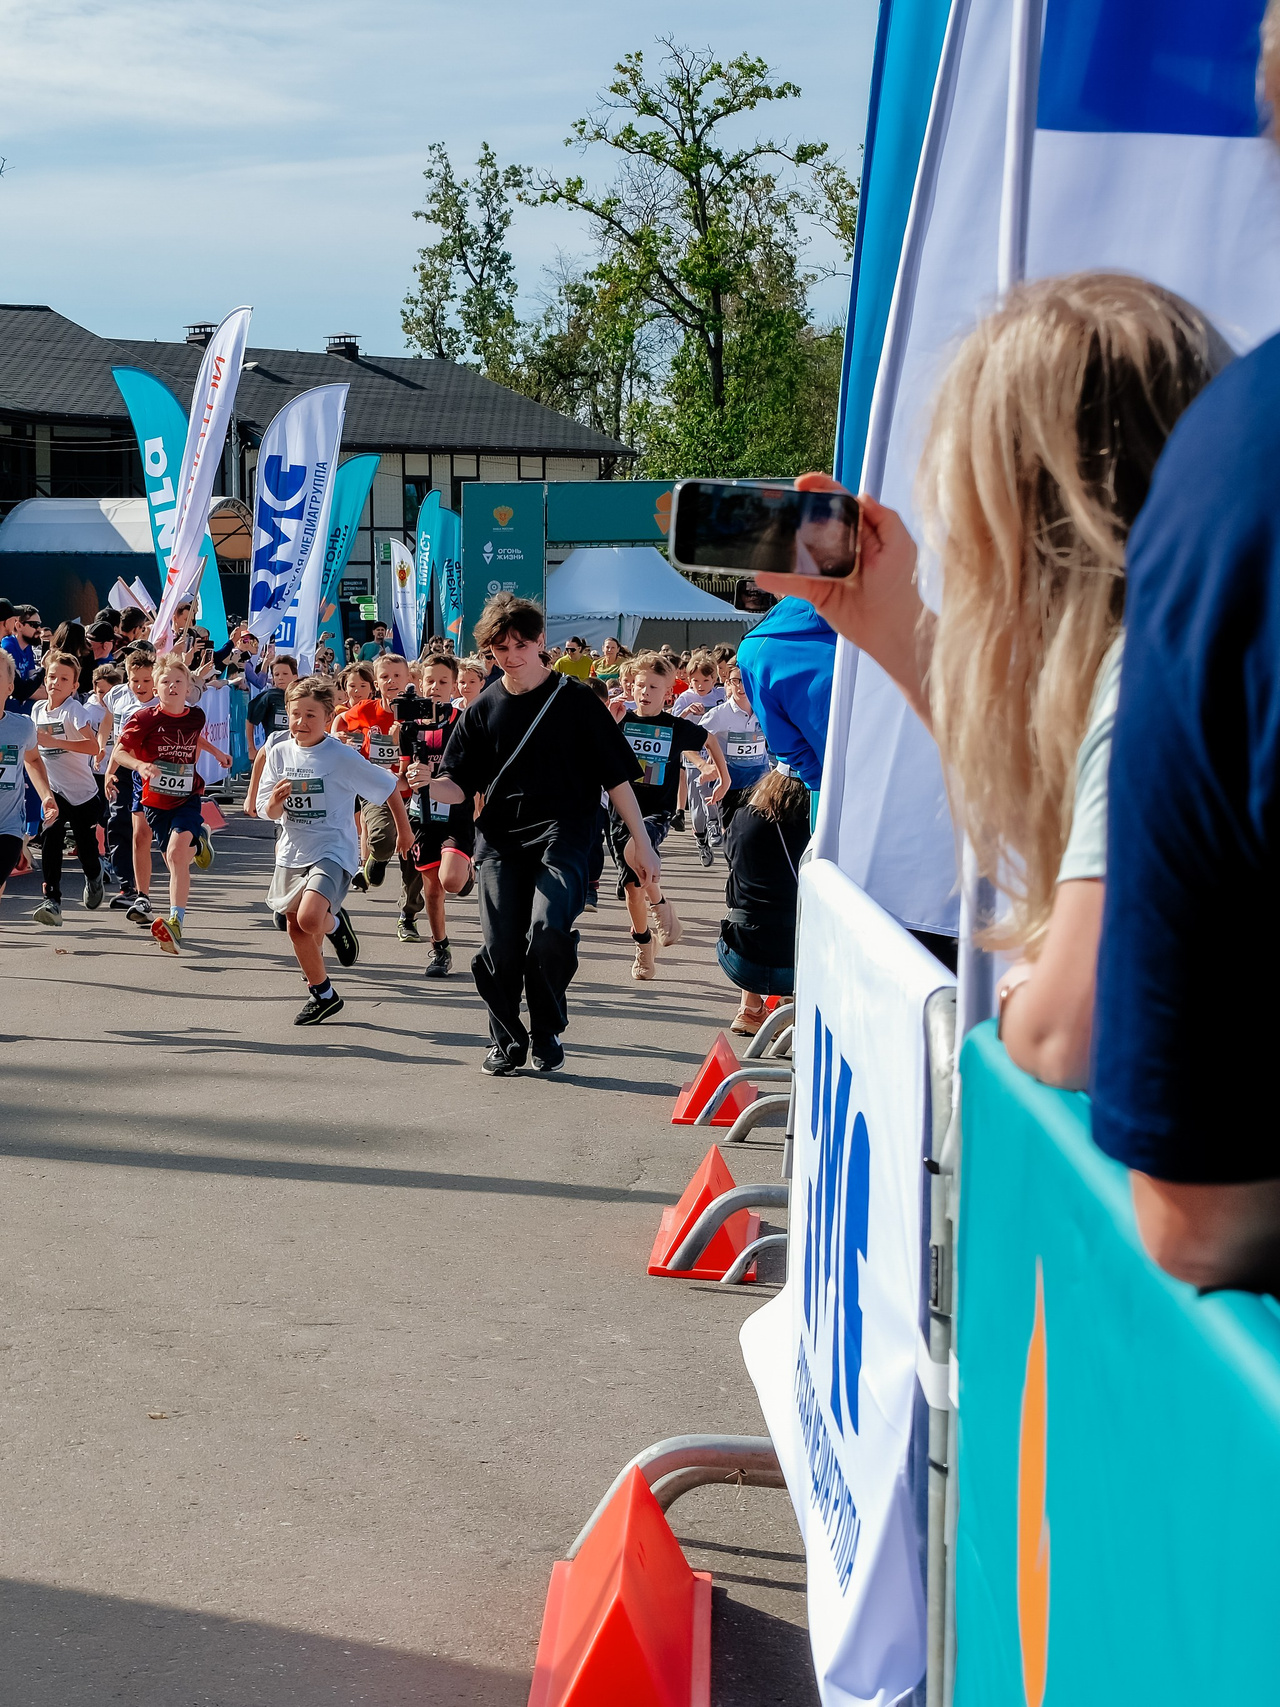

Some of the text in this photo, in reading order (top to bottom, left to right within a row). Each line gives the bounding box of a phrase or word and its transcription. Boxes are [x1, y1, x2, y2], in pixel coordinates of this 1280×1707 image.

[298, 461, 328, 557] МЕДИАГРУППА
[378, 747, 400, 758] 891
[633, 740, 661, 753] 560
[737, 745, 758, 755] 521
[159, 777, 185, 789] 504
[287, 796, 312, 809] 881
